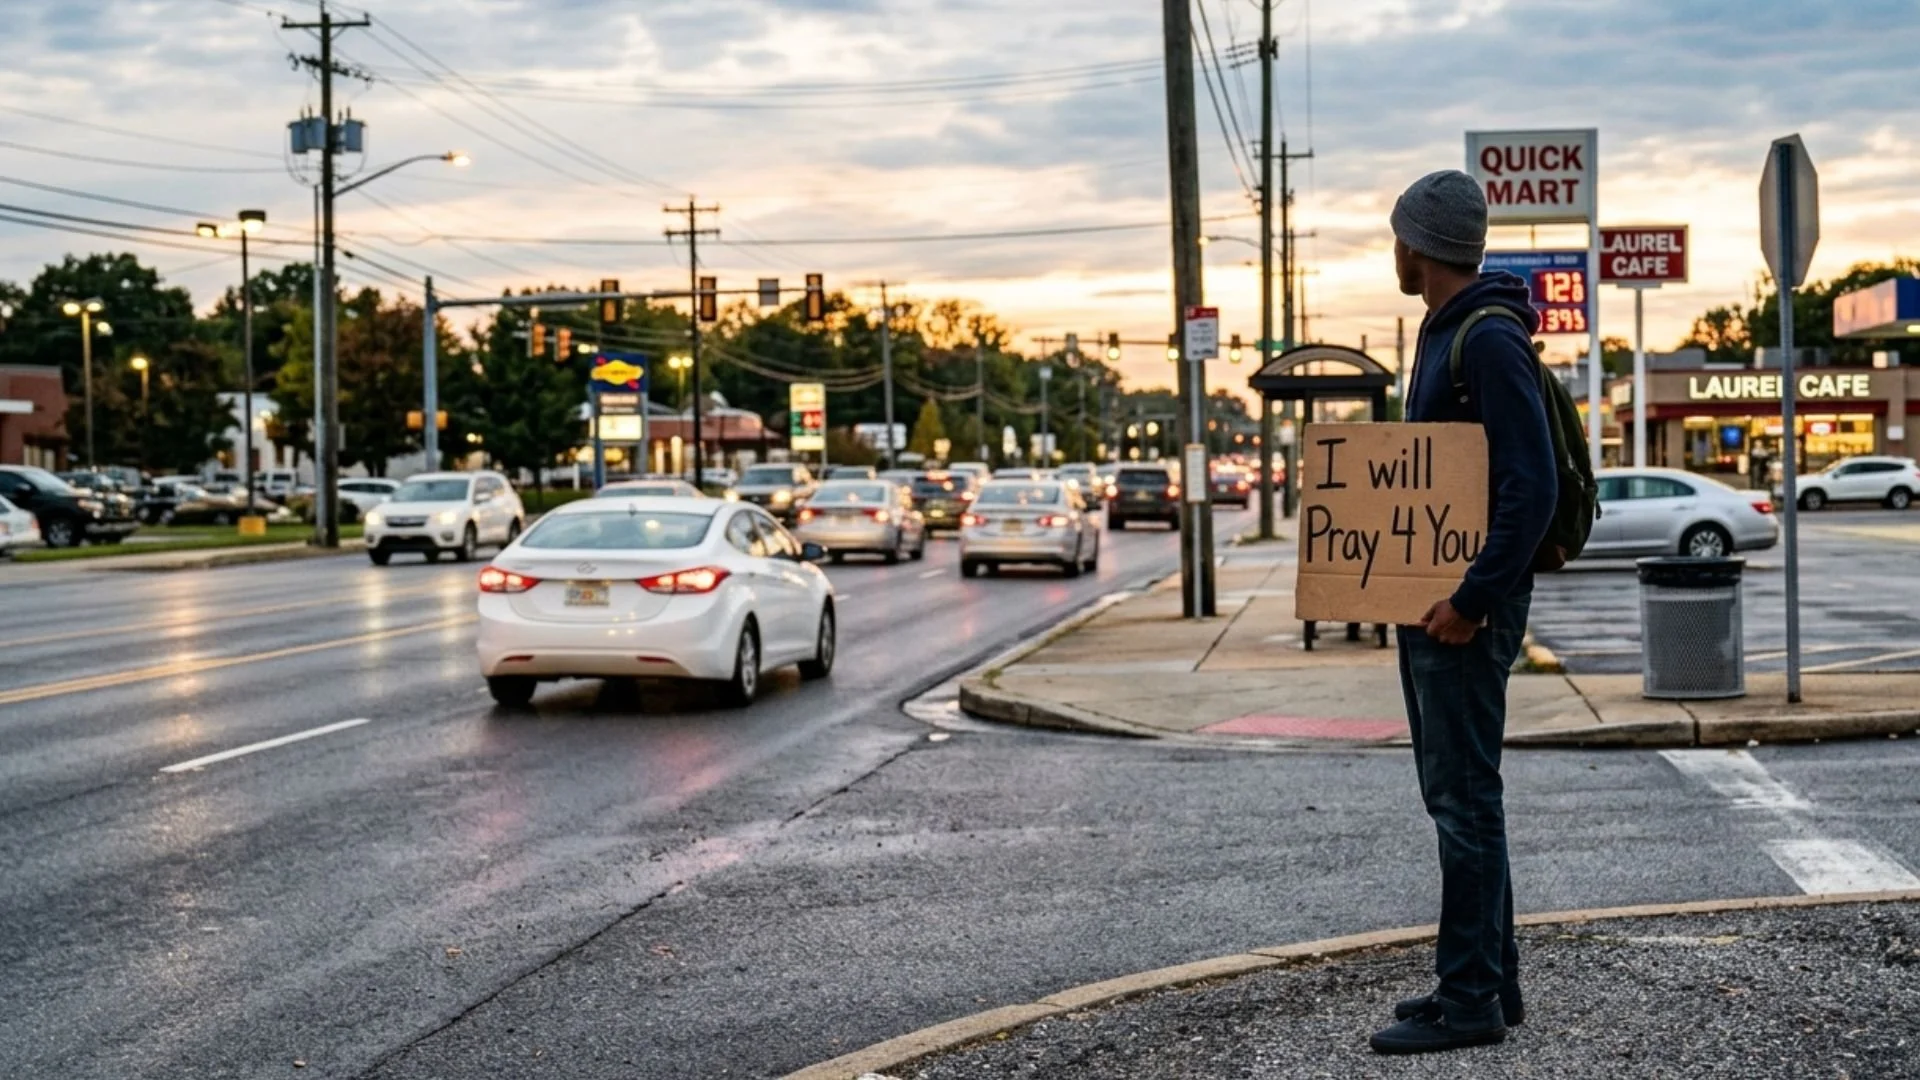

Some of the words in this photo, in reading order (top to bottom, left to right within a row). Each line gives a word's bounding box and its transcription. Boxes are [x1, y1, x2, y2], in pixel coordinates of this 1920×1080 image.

[1480, 144, 1583, 175] QUICK
[1486, 178, 1580, 205] MART
[1600, 232, 1682, 253] LAUREL
[1611, 256, 1669, 276] CAFE
[1799, 374, 1870, 398] CAFE
[1316, 437, 1347, 490] I
[1368, 435, 1432, 489] will
[1306, 504, 1380, 589] Pray
[1391, 504, 1417, 565] 4
[1425, 503, 1481, 567] You
